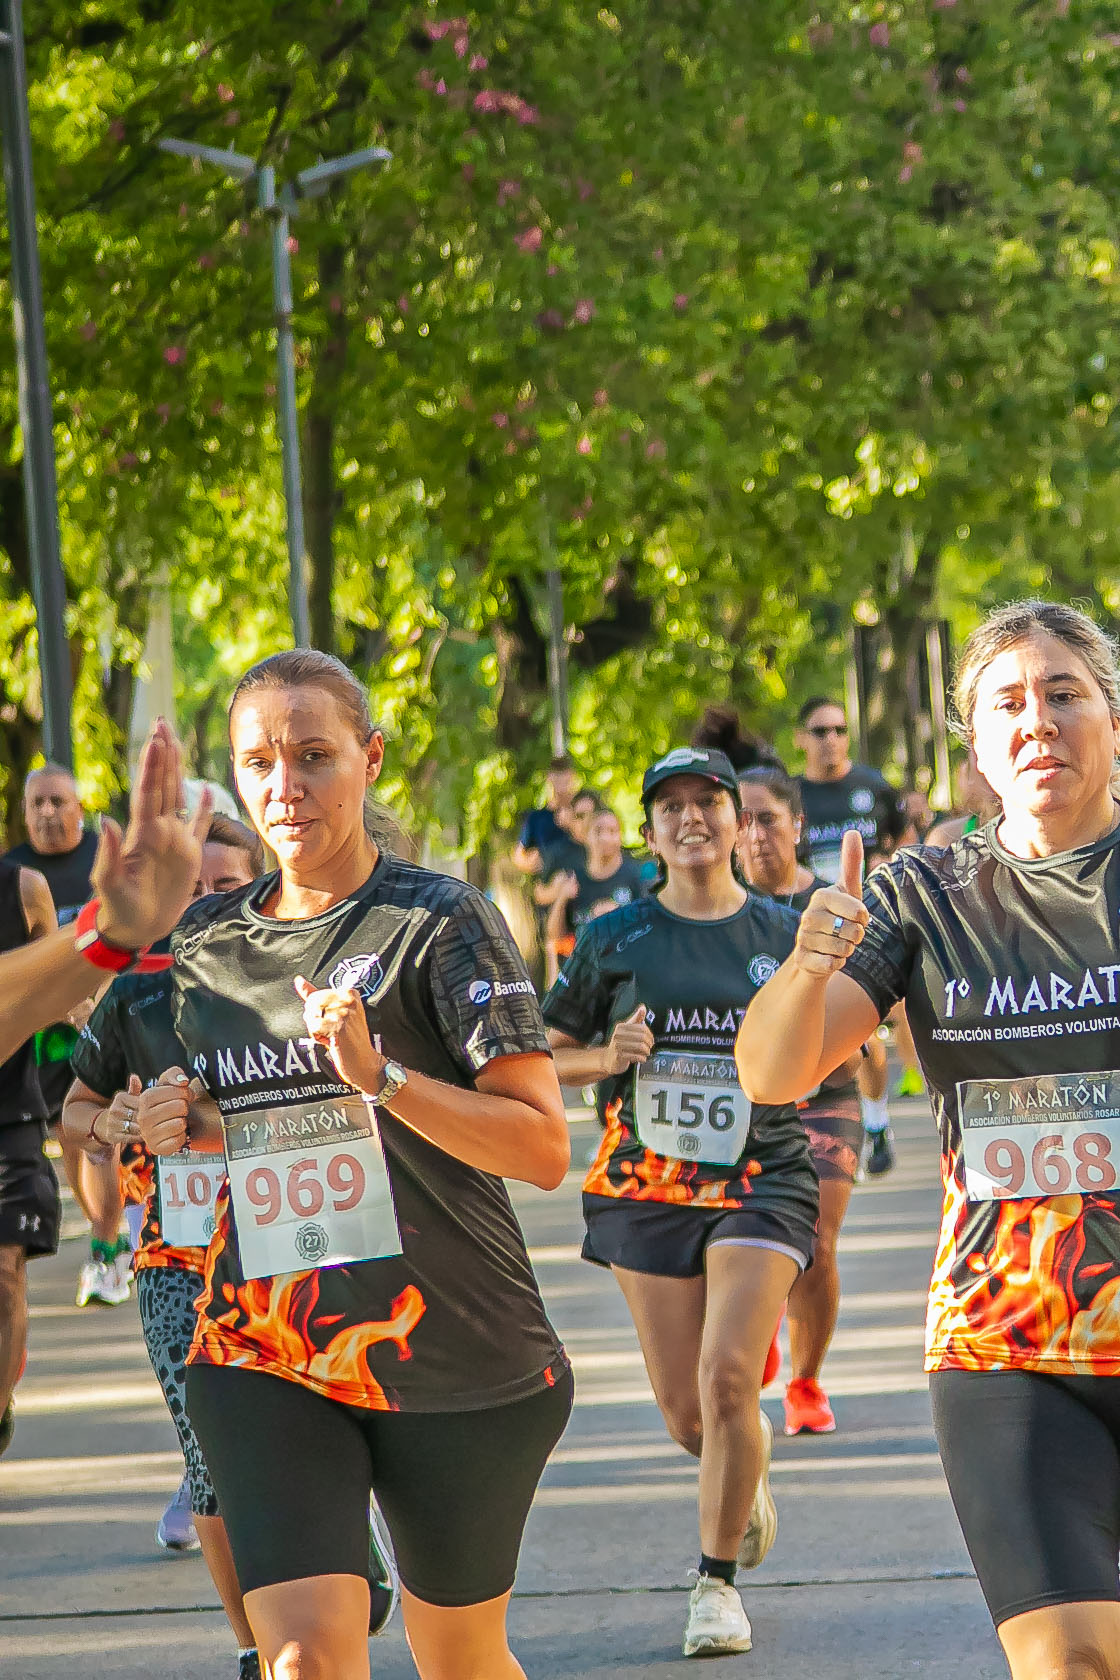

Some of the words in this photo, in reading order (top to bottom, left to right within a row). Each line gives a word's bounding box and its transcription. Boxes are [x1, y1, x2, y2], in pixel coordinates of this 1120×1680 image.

[932, 1026, 992, 1042] ASOCIACIÓN
[994, 1022, 1064, 1040] BOMBEROS
[216, 1034, 382, 1087] MARAT
[670, 1060, 738, 1079] MARATÓN
[231, 1089, 283, 1109] BOMBEROS
[1008, 1078, 1107, 1110] MARATÓN
[264, 1105, 349, 1140] MARATÓN
[651, 1089, 736, 1131] 156
[1048, 1111, 1094, 1122] VOLUNTARIOS
[340, 1127, 371, 1141] ROSARIO
[983, 1132, 1117, 1198] 968
[244, 1153, 366, 1226] 969
[305, 1235, 318, 1248] 27
